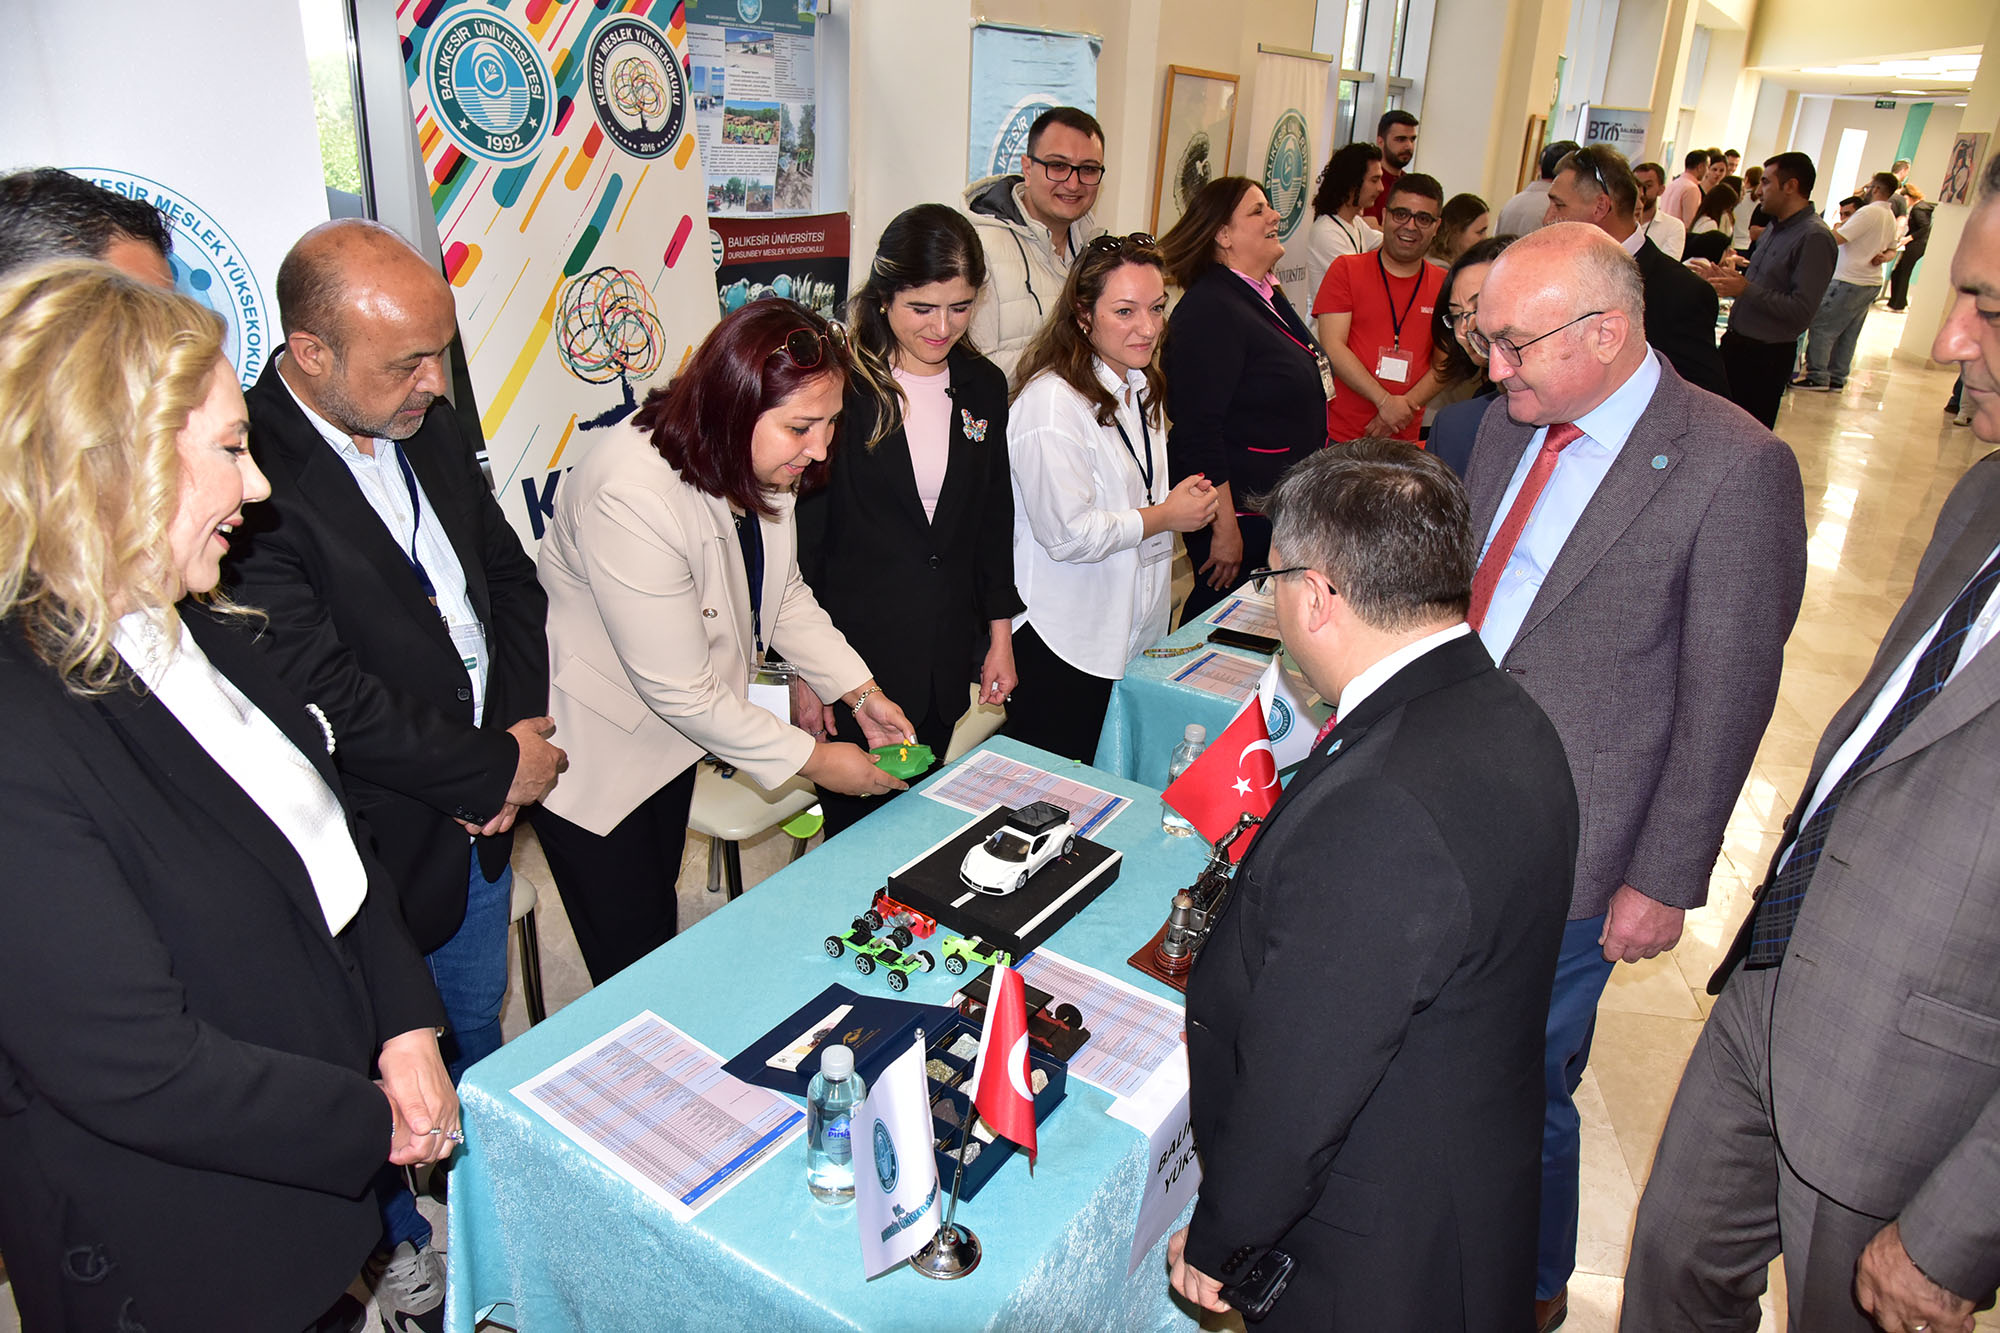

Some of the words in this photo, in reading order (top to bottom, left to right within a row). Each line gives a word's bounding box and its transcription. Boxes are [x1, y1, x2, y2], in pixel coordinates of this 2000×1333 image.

[599, 28, 633, 55] MESLEK
[438, 25, 472, 101] BALIKESİR
[473, 20, 545, 100] ÜNİVERSİTESİ
[635, 29, 681, 106] YÜKSEKOKULU
[593, 54, 607, 106] KEPSUT
[485, 133, 524, 152] 1992
[640, 143, 656, 152] 2016
[154, 194, 227, 257] MESLEK
[728, 232, 770, 248] BALIKESİR
[771, 229, 825, 245] ÜNİVERSİTESİ
[728, 249, 763, 260] DURSUNBEY
[762, 248, 785, 257] MESLEK
[785, 245, 825, 255] YÜKSEKOKULU
